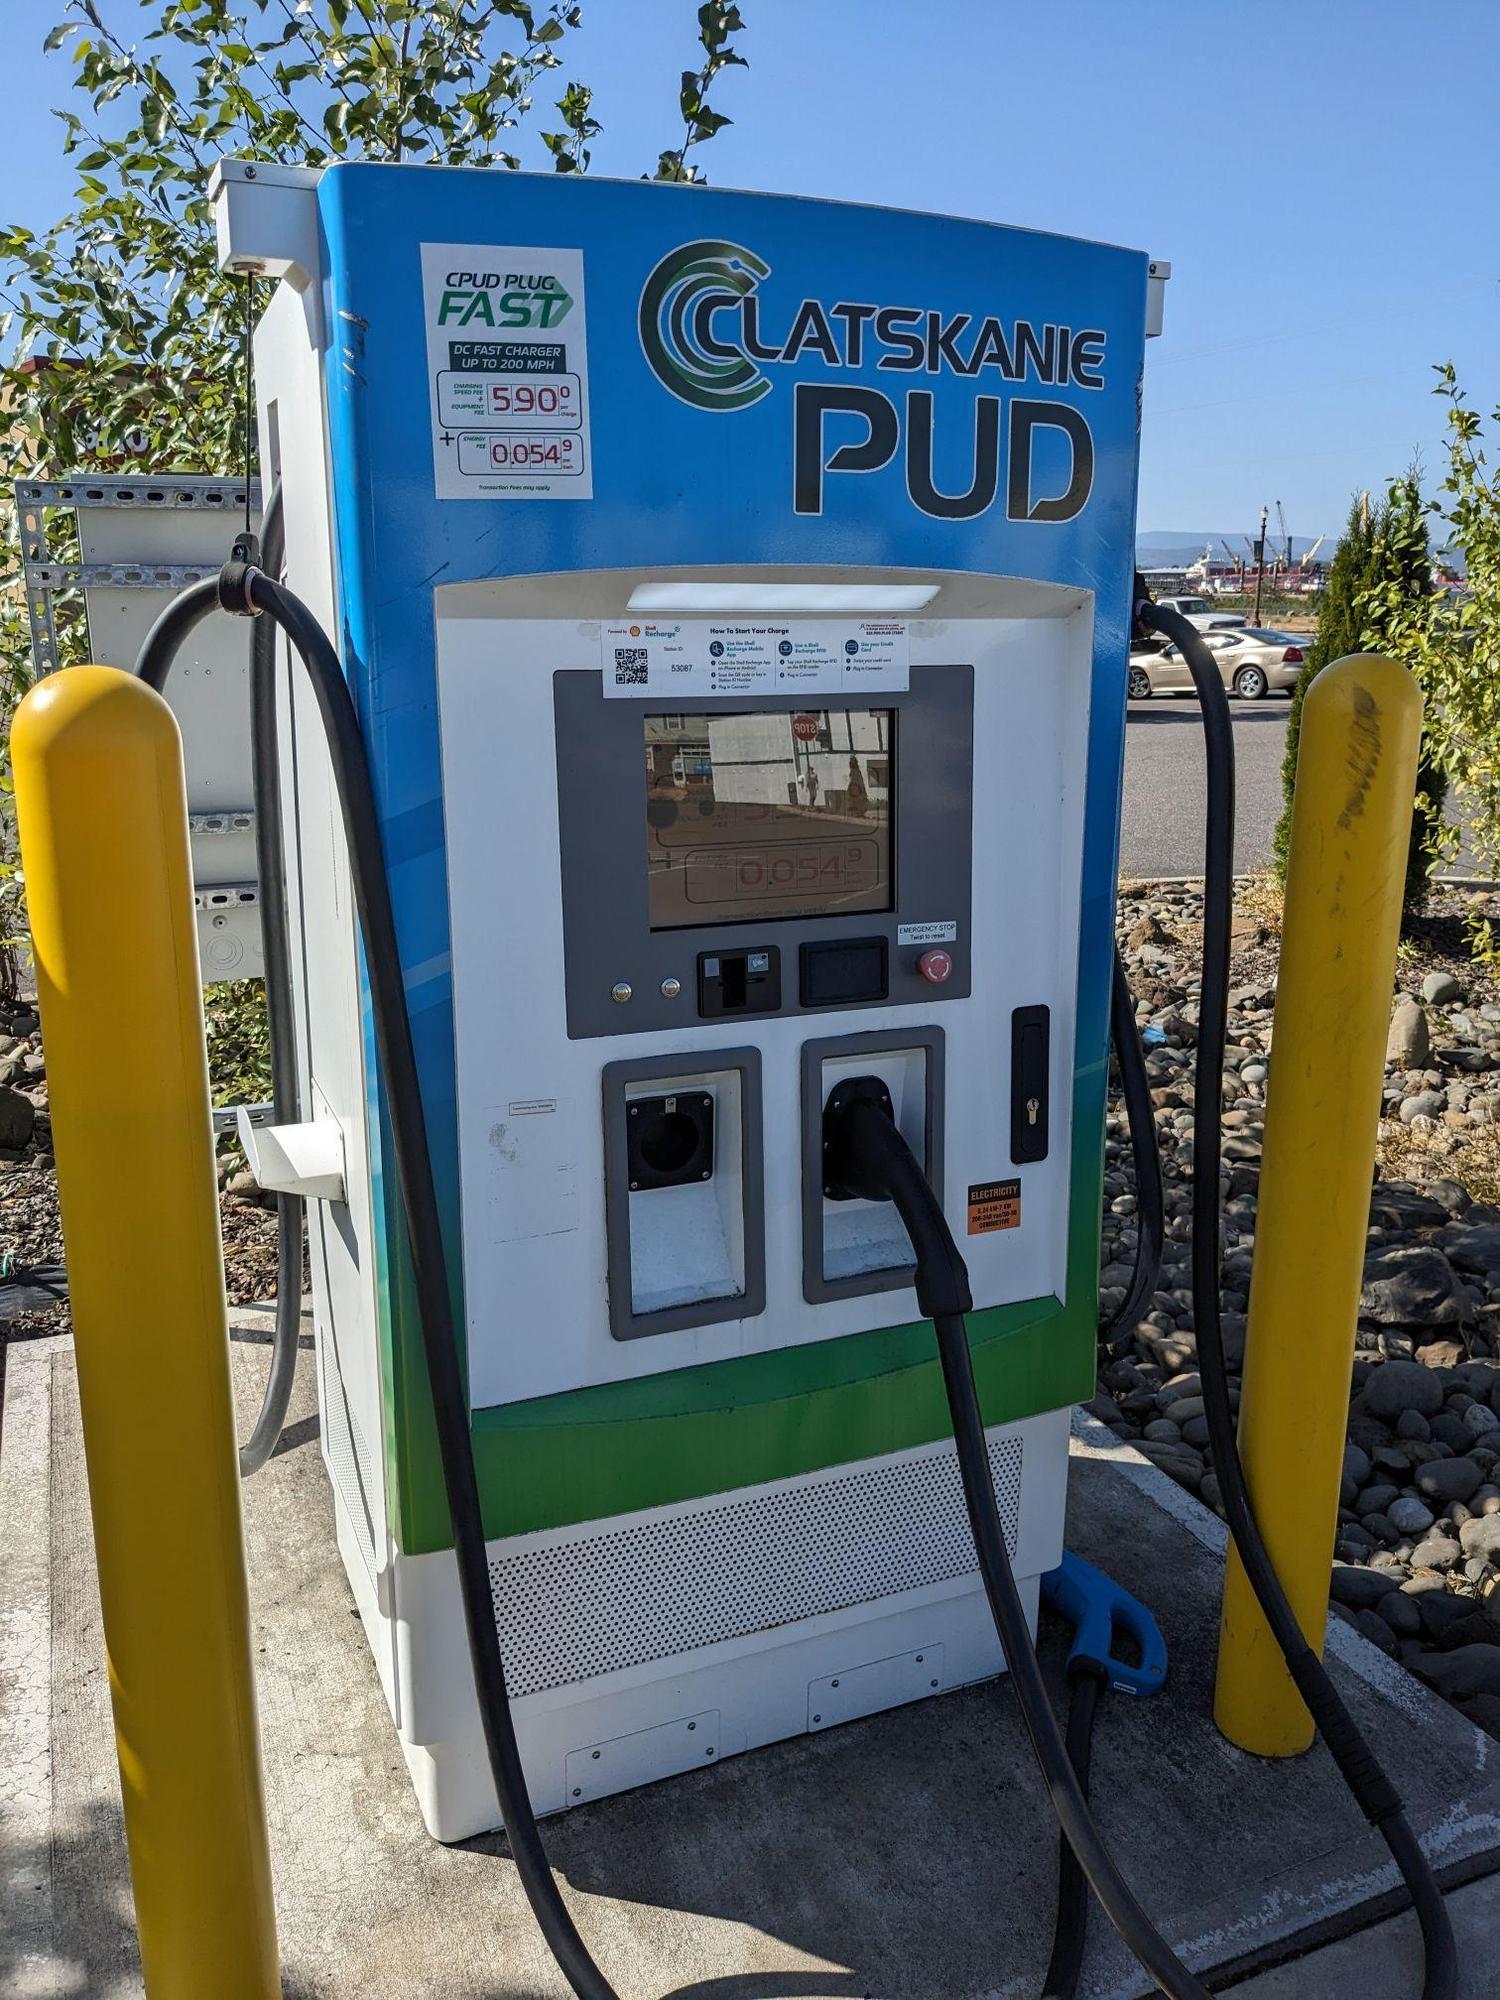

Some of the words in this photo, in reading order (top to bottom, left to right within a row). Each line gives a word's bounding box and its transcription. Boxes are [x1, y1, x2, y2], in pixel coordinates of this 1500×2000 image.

[446, 272, 500, 288] CPUD
[504, 274, 555, 290] PLUG
[437, 291, 569, 328] FAST
[692, 294, 1106, 390] CLATSKANIE
[454, 345, 471, 355] DC
[474, 345, 502, 356] FAST
[505, 346, 561, 357] CHARGER
[462, 358, 478, 368] UP
[483, 359, 497, 369] TO
[501, 359, 523, 369] 200
[527, 360, 555, 370] MPH
[562, 439, 572, 452] 9
[793, 382, 1095, 524] PUD
[671, 664, 692, 672] 53087
[900, 925, 938, 934] EMERGENCY
[939, 923, 955, 931] STOP
[971, 1185, 1018, 1200] ELECTRICITY
